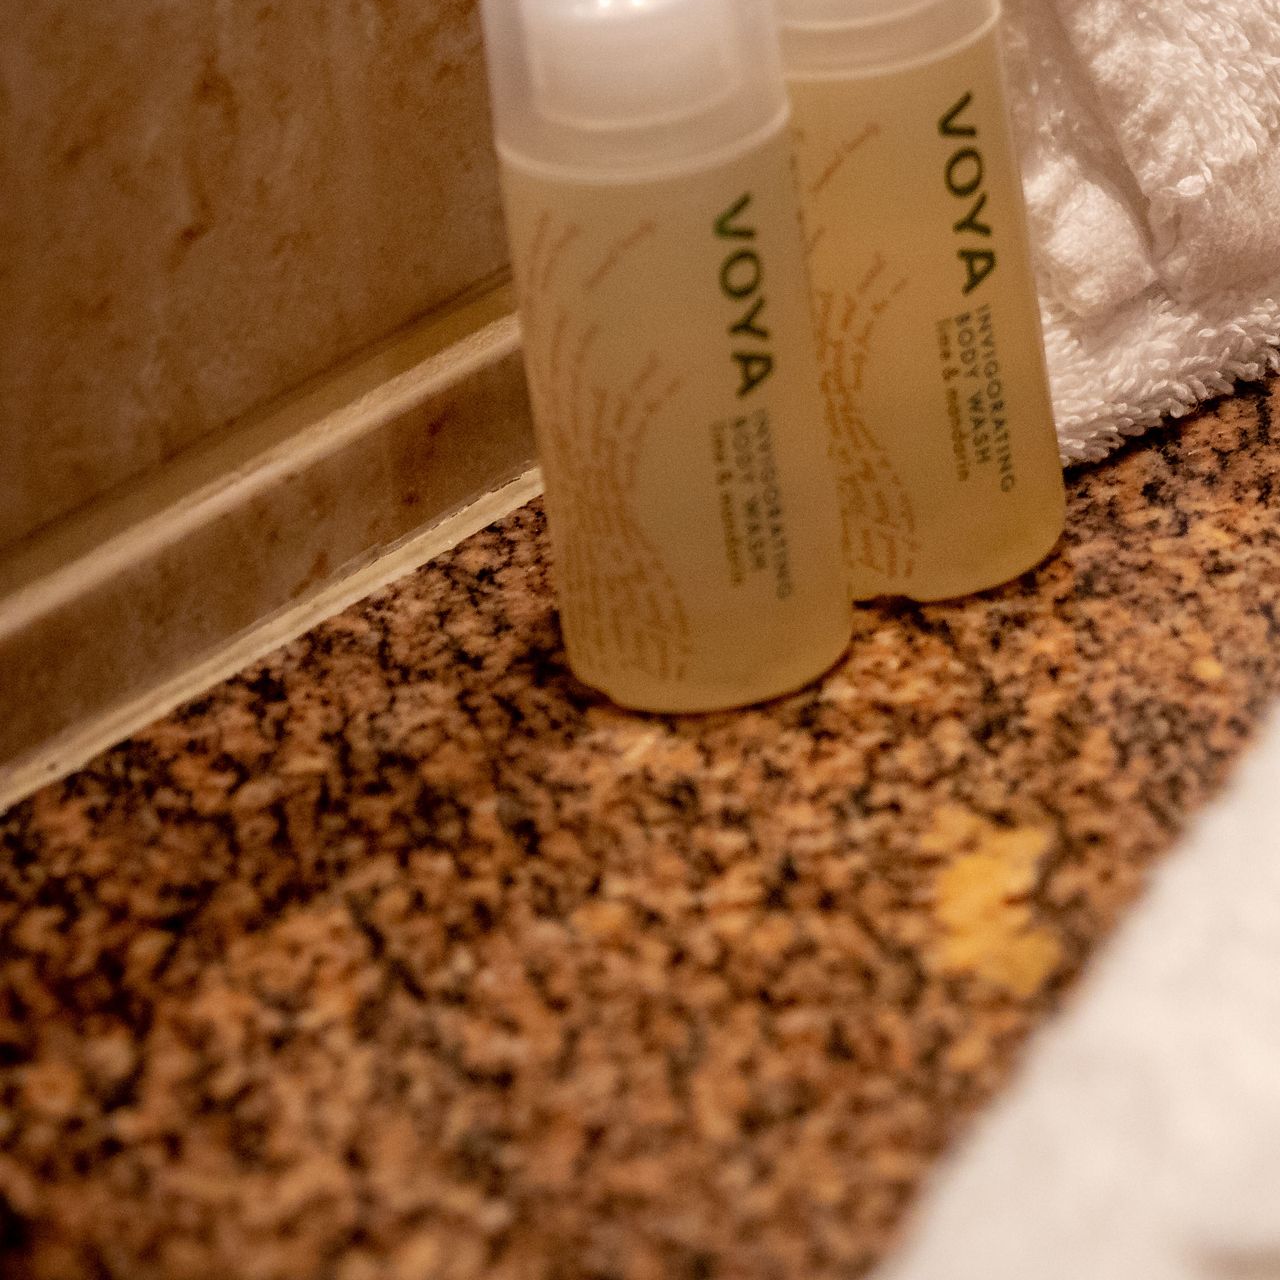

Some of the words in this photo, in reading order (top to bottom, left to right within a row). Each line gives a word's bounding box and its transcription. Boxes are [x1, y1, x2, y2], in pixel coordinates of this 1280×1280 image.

[938, 91, 997, 297] VOYA
[713, 192, 775, 400] VOYA
[956, 311, 980, 378] BODY
[968, 389, 991, 464] WASH
[976, 303, 1016, 493] INVIGORATING
